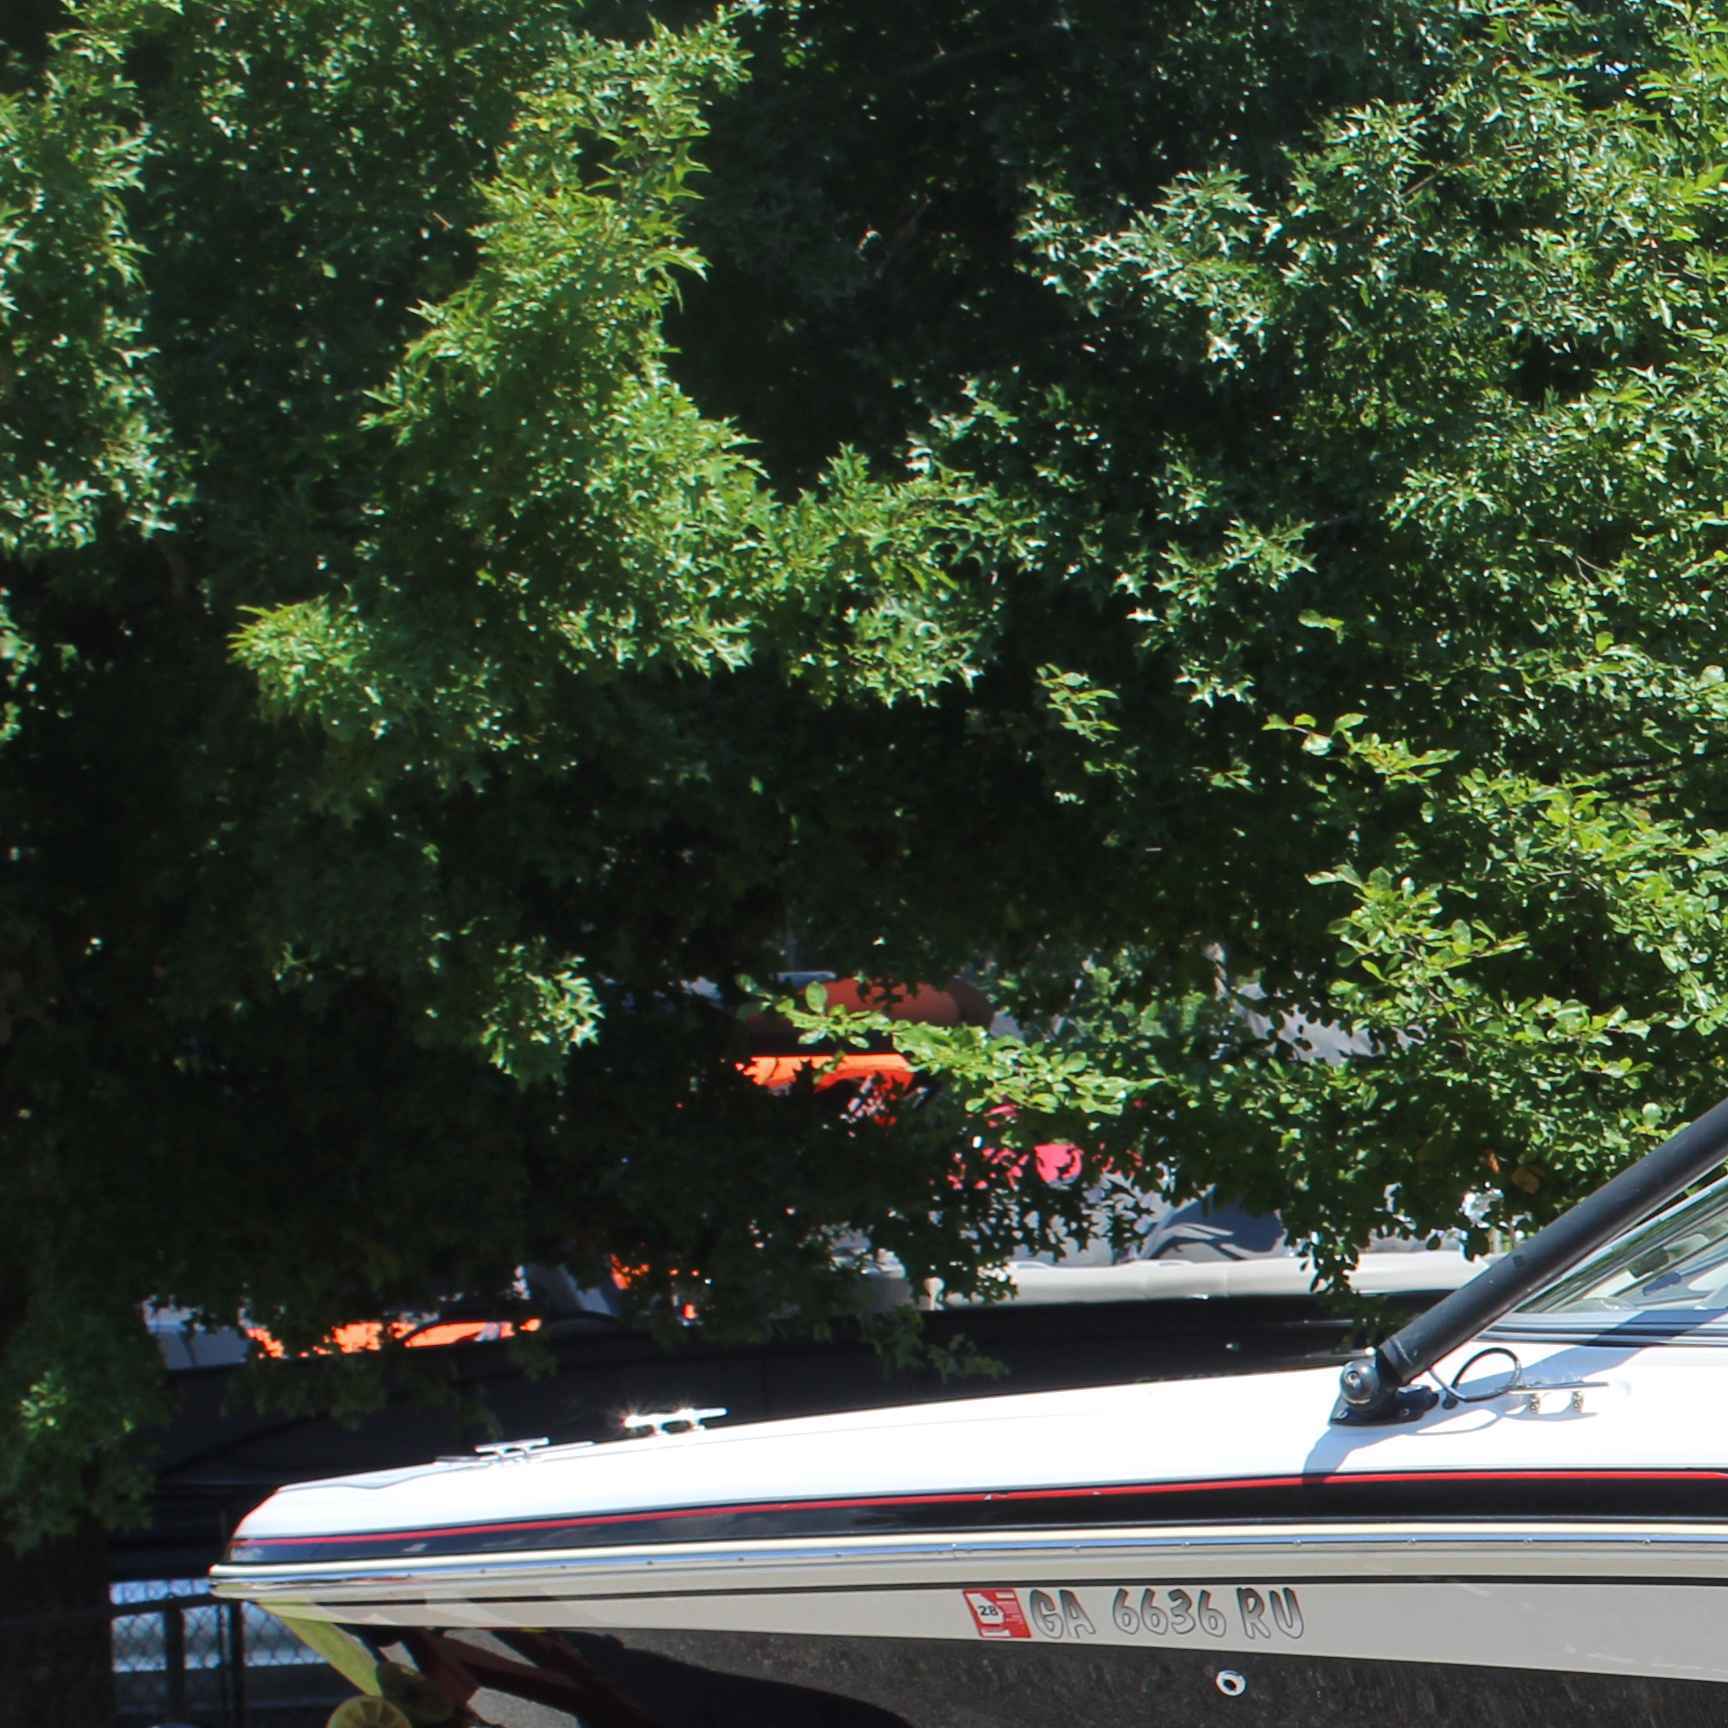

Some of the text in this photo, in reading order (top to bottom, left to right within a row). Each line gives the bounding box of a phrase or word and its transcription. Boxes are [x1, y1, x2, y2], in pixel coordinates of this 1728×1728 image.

[1029, 1587, 1096, 1640] GA
[1111, 1587, 1227, 1638] 6636
[1236, 1585, 1304, 1640] RU
